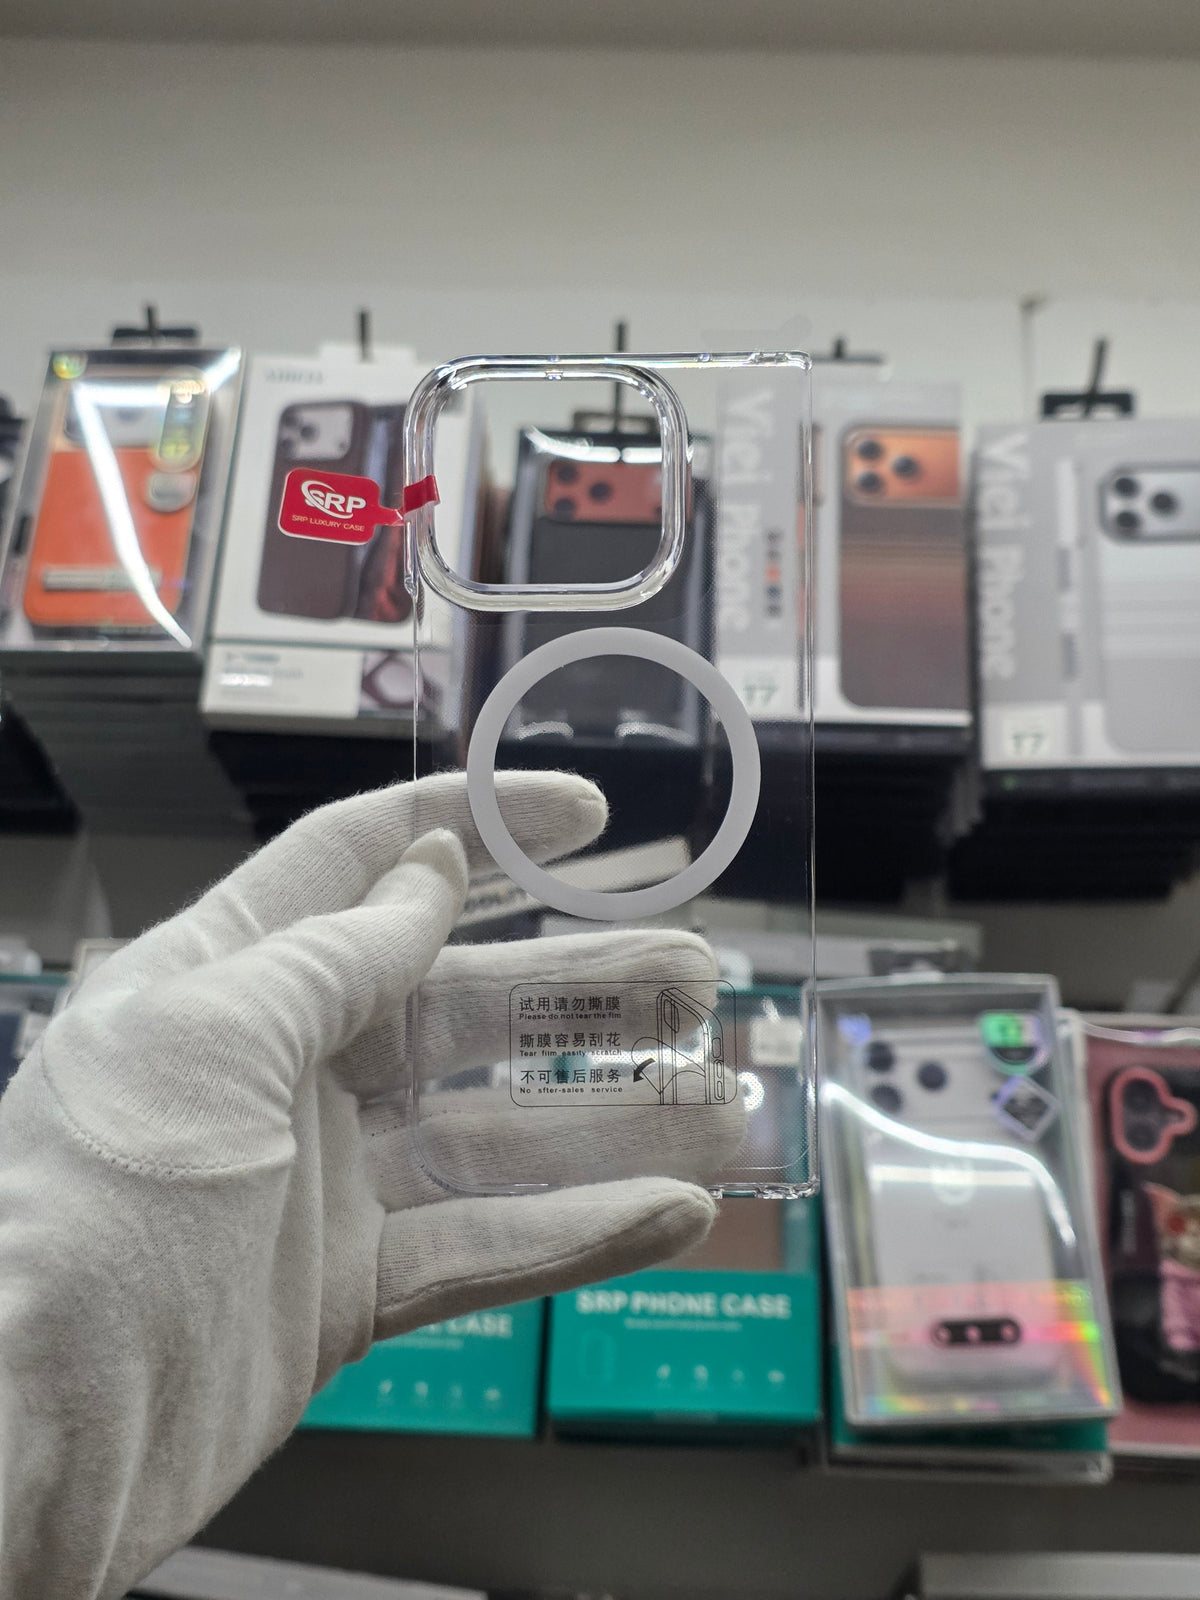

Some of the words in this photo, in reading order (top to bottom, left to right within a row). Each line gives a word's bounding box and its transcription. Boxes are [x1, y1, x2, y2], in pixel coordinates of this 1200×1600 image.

[303, 487, 367, 514] SRP
[291, 514, 308, 523] SRP
[309, 517, 342, 528] LUXURY
[343, 523, 365, 532] CASE
[519, 996, 621, 1012] 试用请勿撕膜
[519, 1013, 547, 1021] Please
[519, 1032, 621, 1048] 撕膜容易刮花
[520, 1069, 622, 1085] 不可售后服务
[576, 1290, 628, 1314] SRP
[630, 1291, 717, 1317] PHONE
[720, 1293, 792, 1319] CASE
